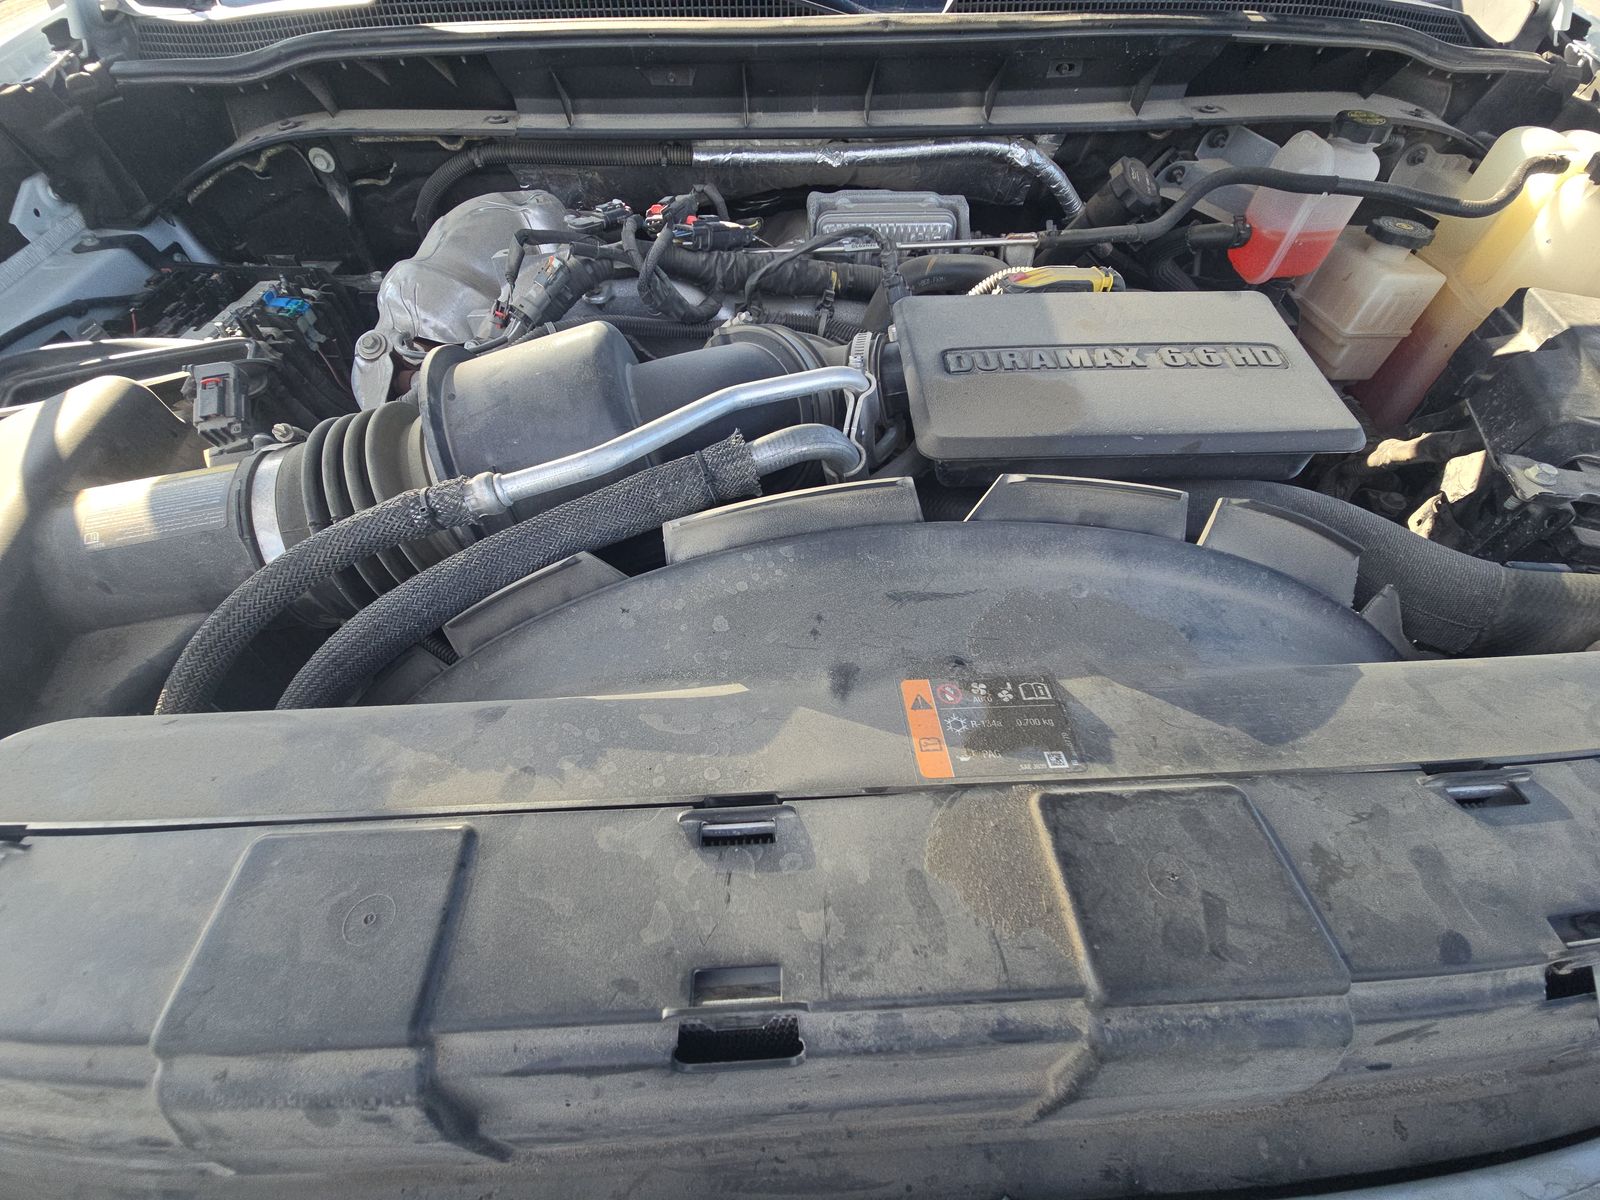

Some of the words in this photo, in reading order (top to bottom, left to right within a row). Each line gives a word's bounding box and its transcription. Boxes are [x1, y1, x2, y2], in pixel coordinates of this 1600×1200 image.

[950, 347, 1147, 373] DURAMAX
[1163, 346, 1223, 368] 6.6
[1230, 347, 1282, 367] HD
[973, 693, 993, 703] AUTO
[970, 719, 1003, 728] R-134a
[1041, 718, 1055, 727] kg
